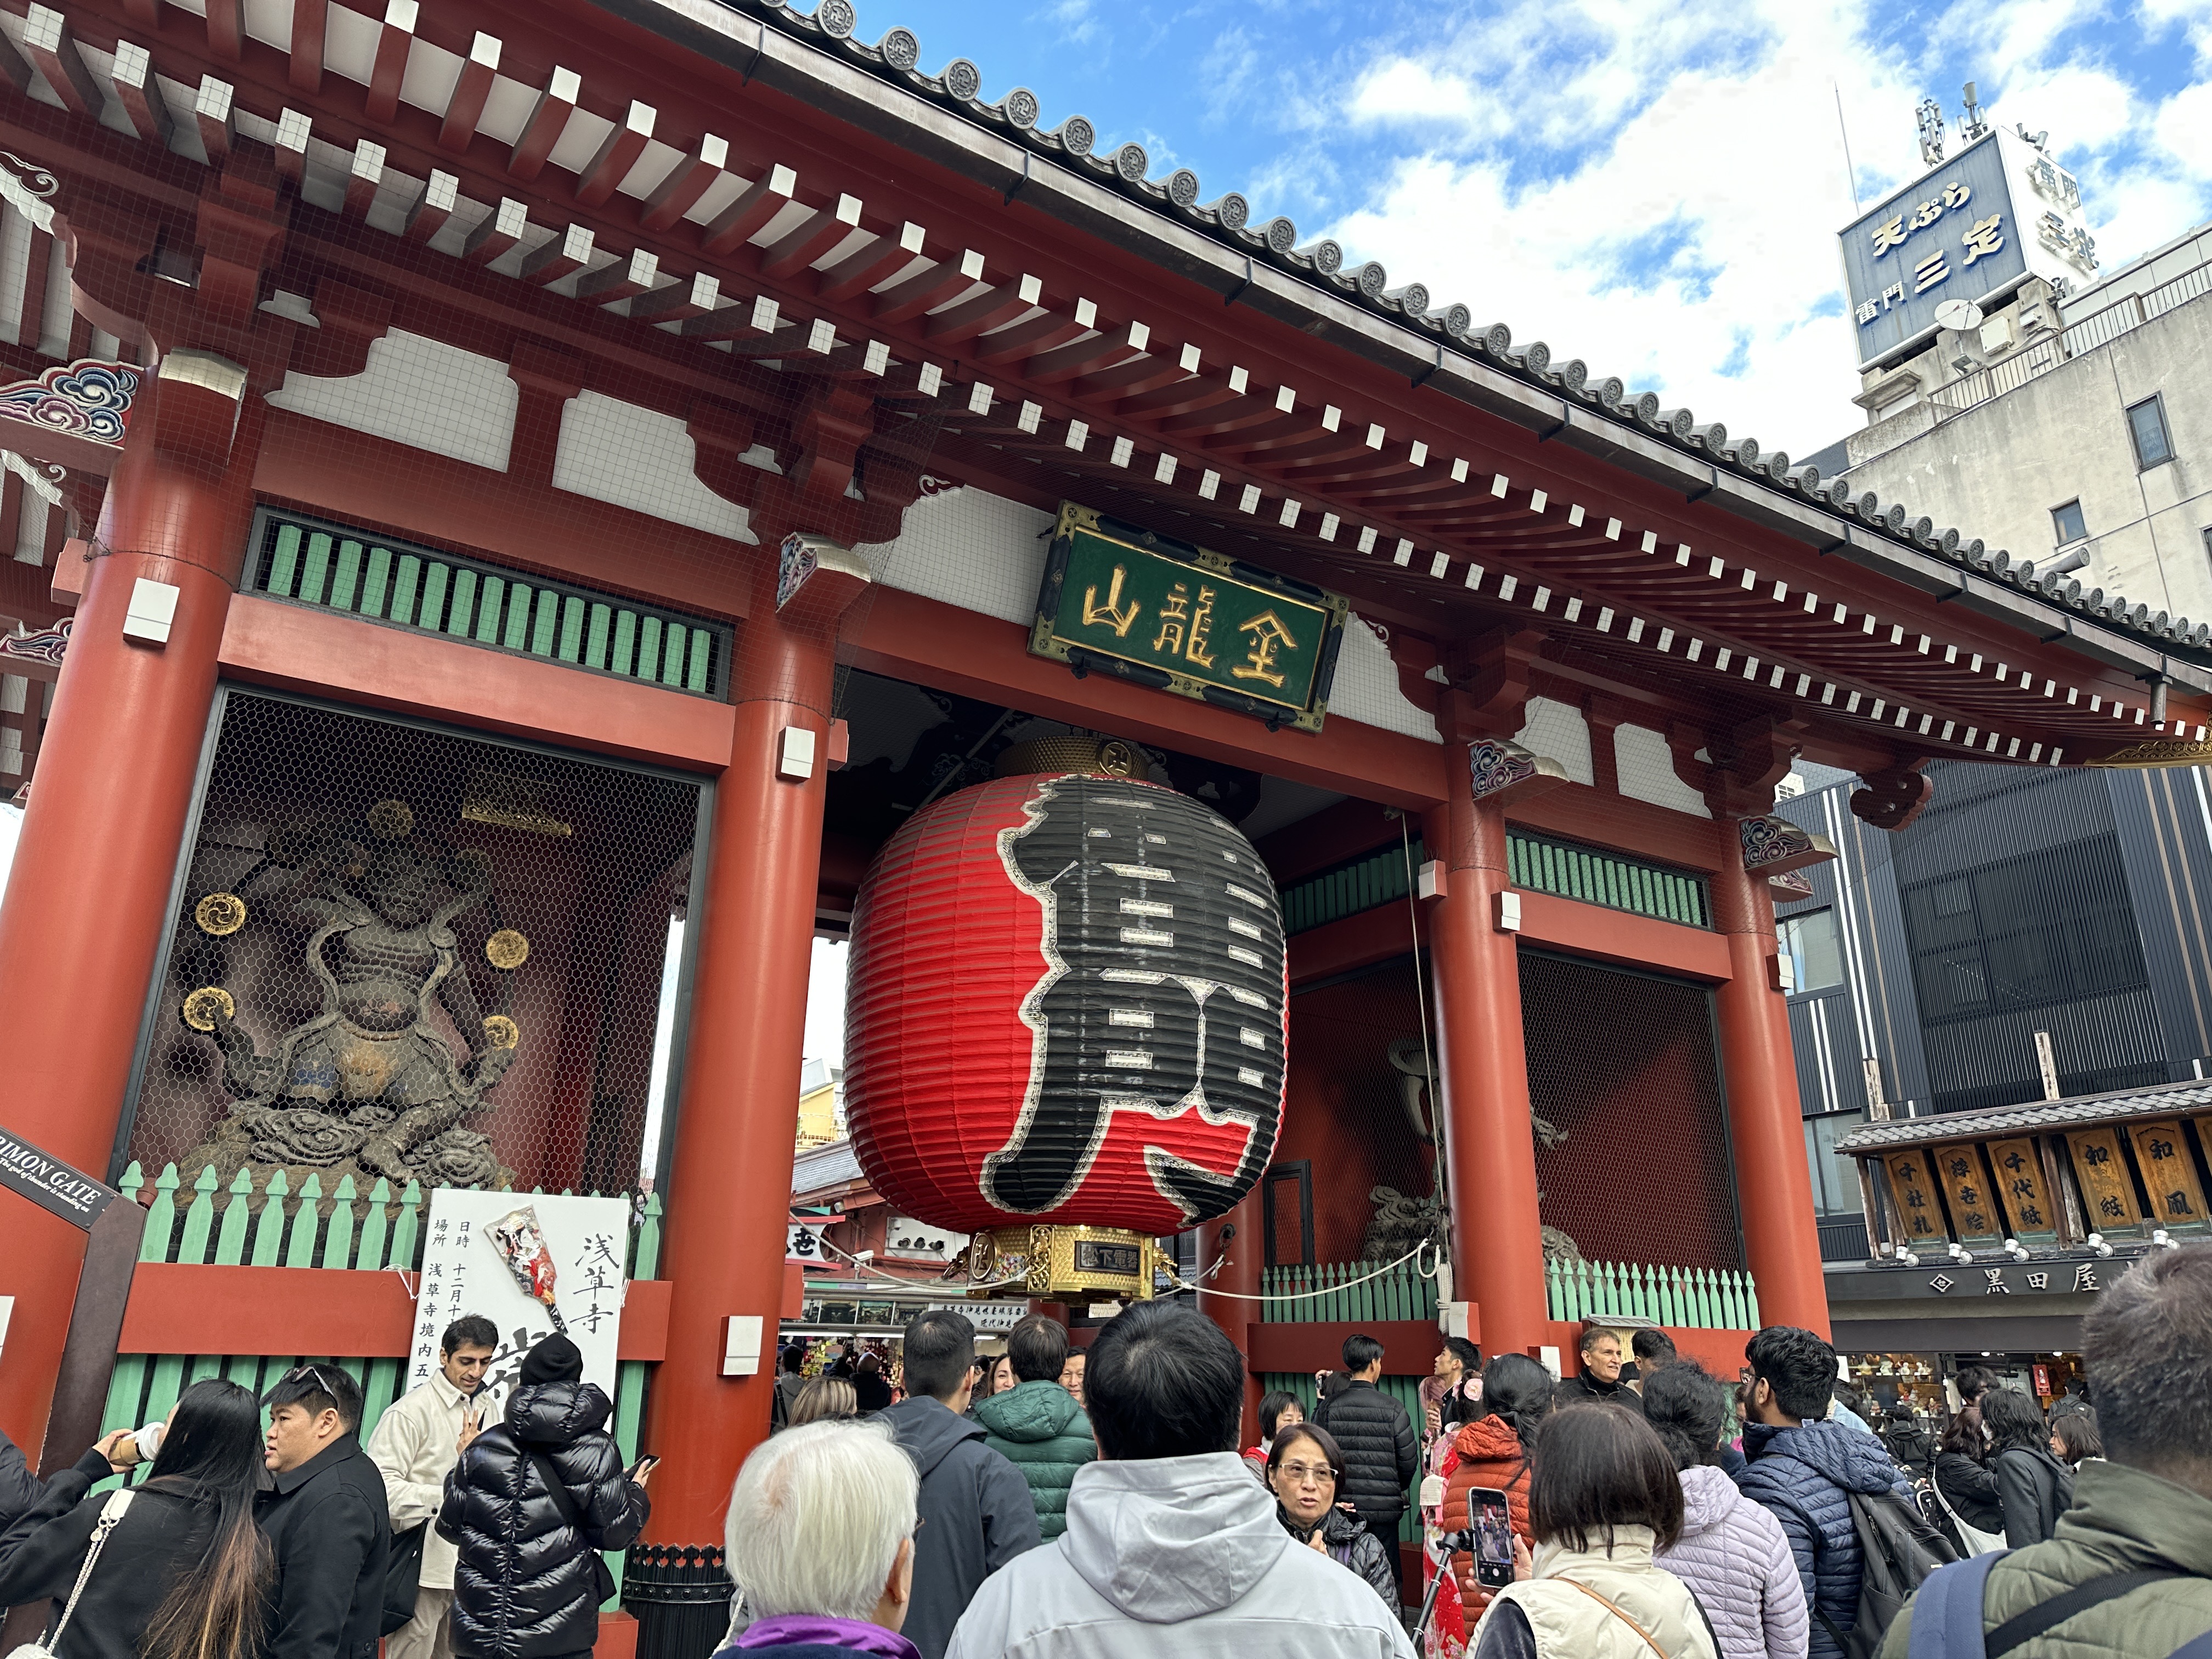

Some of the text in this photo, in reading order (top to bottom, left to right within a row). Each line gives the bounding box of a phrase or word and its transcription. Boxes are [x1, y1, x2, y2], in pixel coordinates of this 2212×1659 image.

[1871, 182, 1970, 257] 天ぷら
[1855, 214, 2004, 325] 雷門 三定
[979, 772, 1288, 1228] 雷門
[27, 1175, 51, 1190] thunder
[56, 1192, 82, 1209] standing
[50, 1172, 101, 1204] GATE
[1899, 1162, 1933, 1234] 千社札
[1950, 1158, 1984, 1230] 浮世絵
[2005, 1152, 2043, 1225] 千代紙
[2085, 1144, 2125, 1217] 和紙
[456, 1221, 470, 1248] 日時
[786, 1227, 816, 1256] せ
[1083, 1246, 1138, 1269] 松下電器
[413, 1219, 448, 1388] 場所 浅草寺境内五
[569, 1233, 619, 1334] 浅草寺
[1984, 1263, 2100, 1294] 黒田屋
